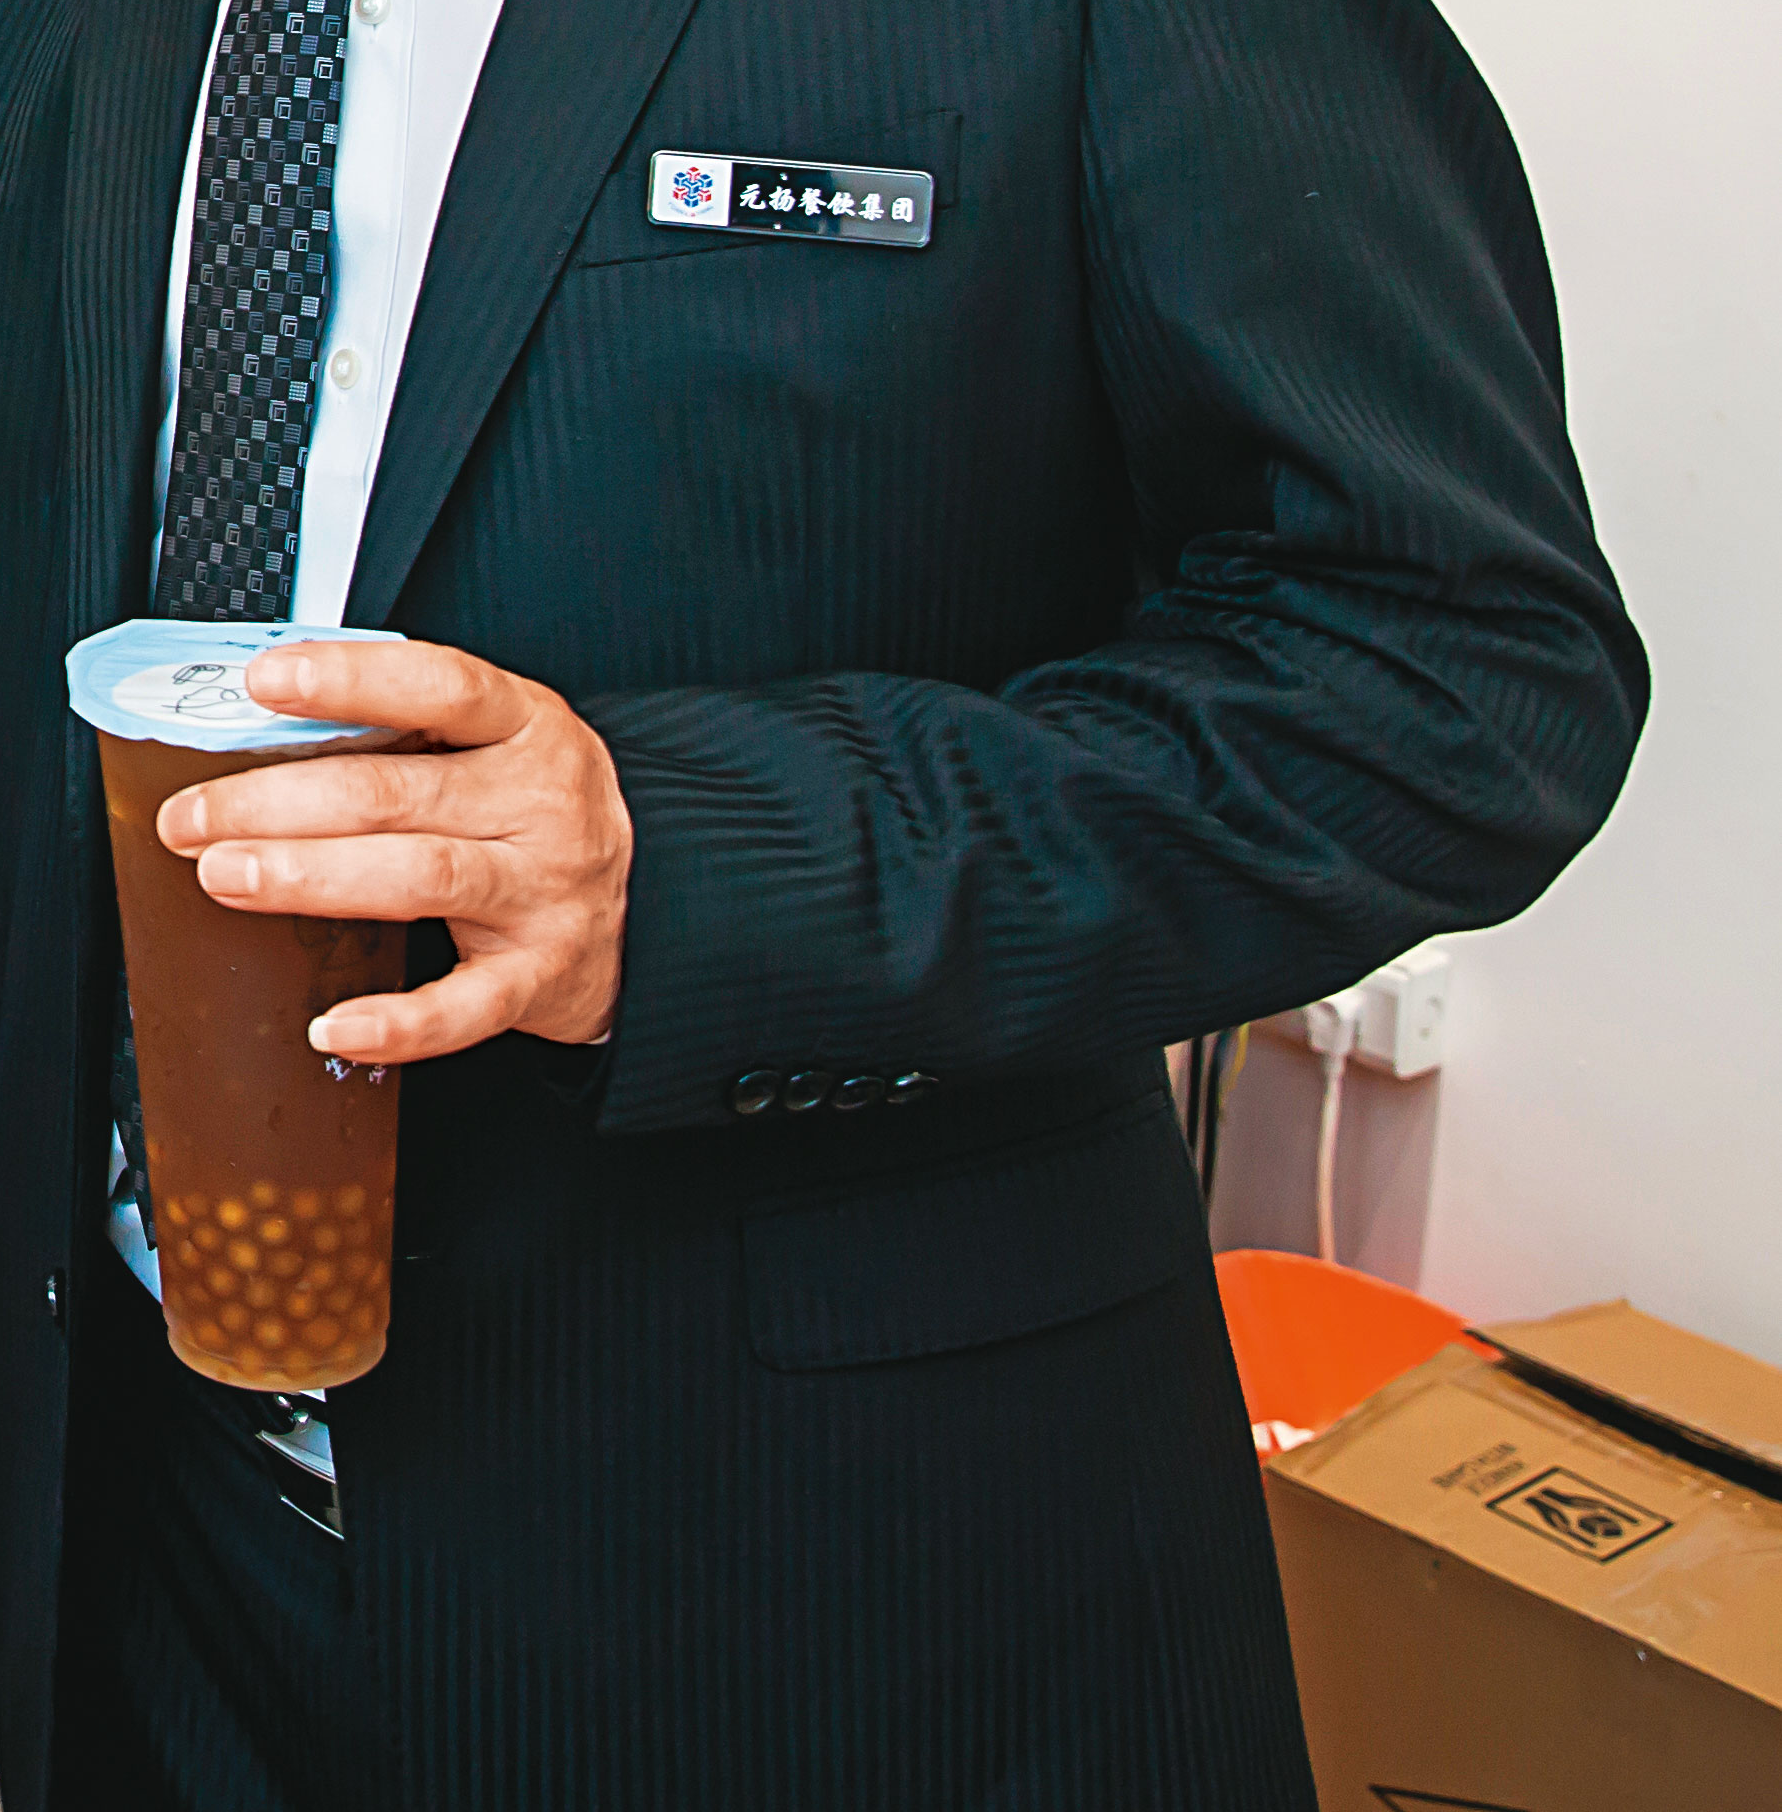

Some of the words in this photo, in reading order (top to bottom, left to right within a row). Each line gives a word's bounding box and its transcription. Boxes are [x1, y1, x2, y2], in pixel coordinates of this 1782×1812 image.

[738, 182, 916, 224] 元扬餐饮集团
